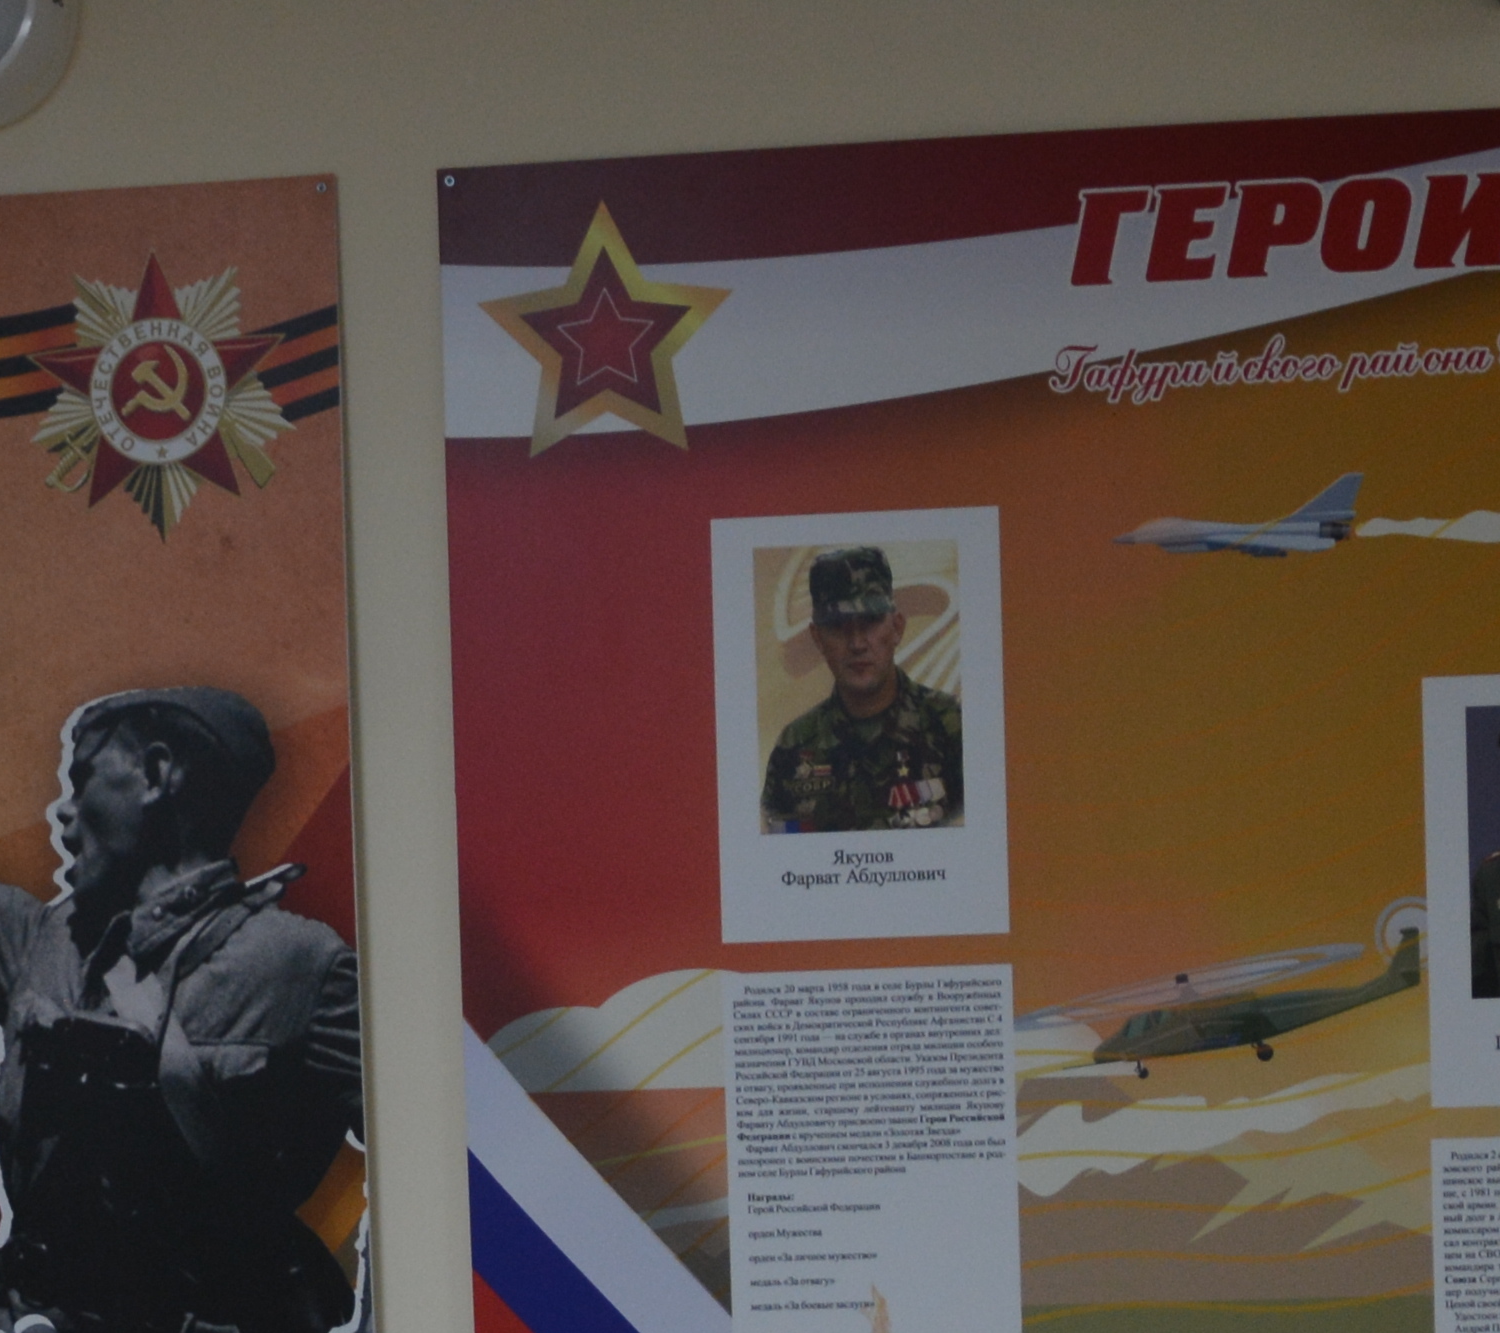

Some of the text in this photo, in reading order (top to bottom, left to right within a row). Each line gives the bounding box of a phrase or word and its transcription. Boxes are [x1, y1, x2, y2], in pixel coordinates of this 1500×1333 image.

[1050, 333, 1338, 405] Гафурийского
[1339, 341, 1493, 390] района
[93, 321, 224, 452] ОТЕЧЕСТВЕННАЯ ВОЙНА
[833, 850, 894, 867] Якупов
[781, 867, 946, 889] Фарват Абдуллович
[748, 1202, 881, 1215] Герой Российской Федерации
[749, 1228, 822, 1239] орден Мужества
[749, 1254, 775, 1264] орден
[750, 1278, 782, 1287] медаль
[751, 1302, 782, 1311] медаль
